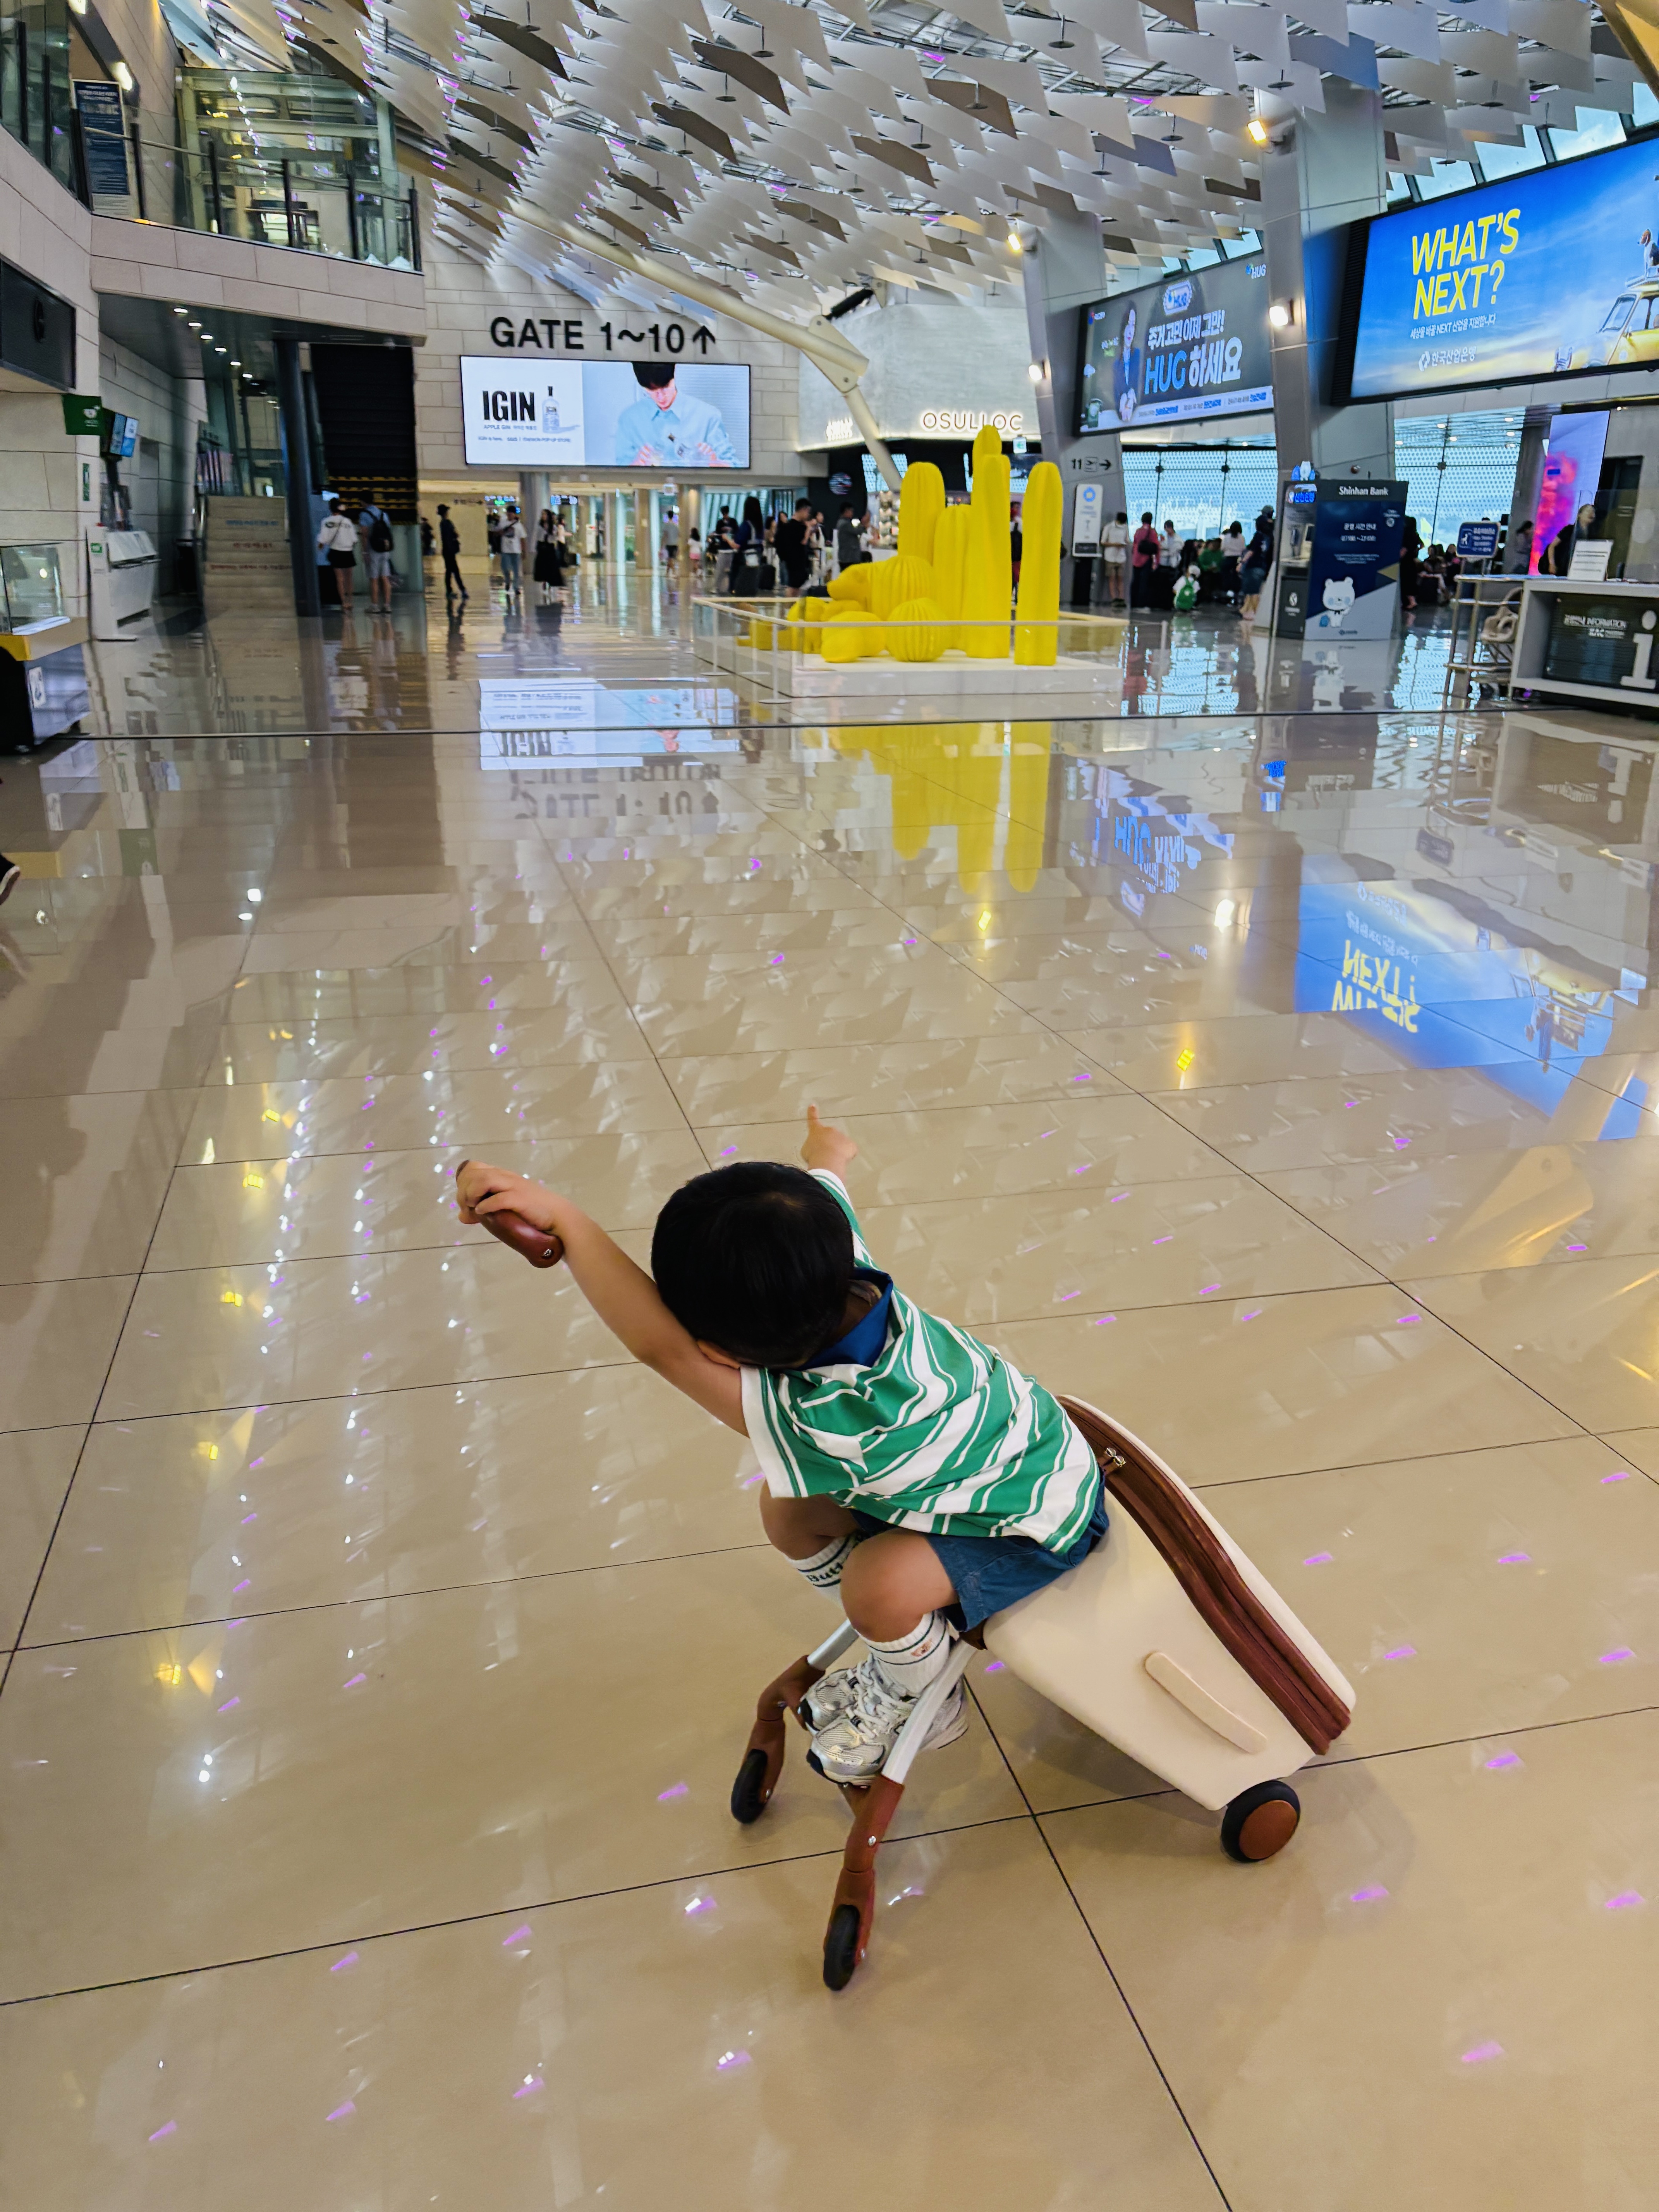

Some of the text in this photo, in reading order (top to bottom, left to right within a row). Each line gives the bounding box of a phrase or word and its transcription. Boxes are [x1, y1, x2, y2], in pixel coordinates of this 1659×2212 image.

[1412, 208, 1521, 275] WHAT'S
[1251, 264, 1266, 279] HUG
[1413, 260, 1505, 319] NEXT?
[490, 317, 684, 353] GATE 1~10
[1436, 322, 1452, 335] NEXT
[1144, 337, 1242, 394] HUG 하세요
[1432, 346, 1477, 367] 한국산업은행
[483, 390, 536, 421] IGIN
[923, 412, 1022, 431] OSULLOC
[1072, 459, 1082, 470] 11
[1339, 486, 1389, 496] Shinhan Bank
